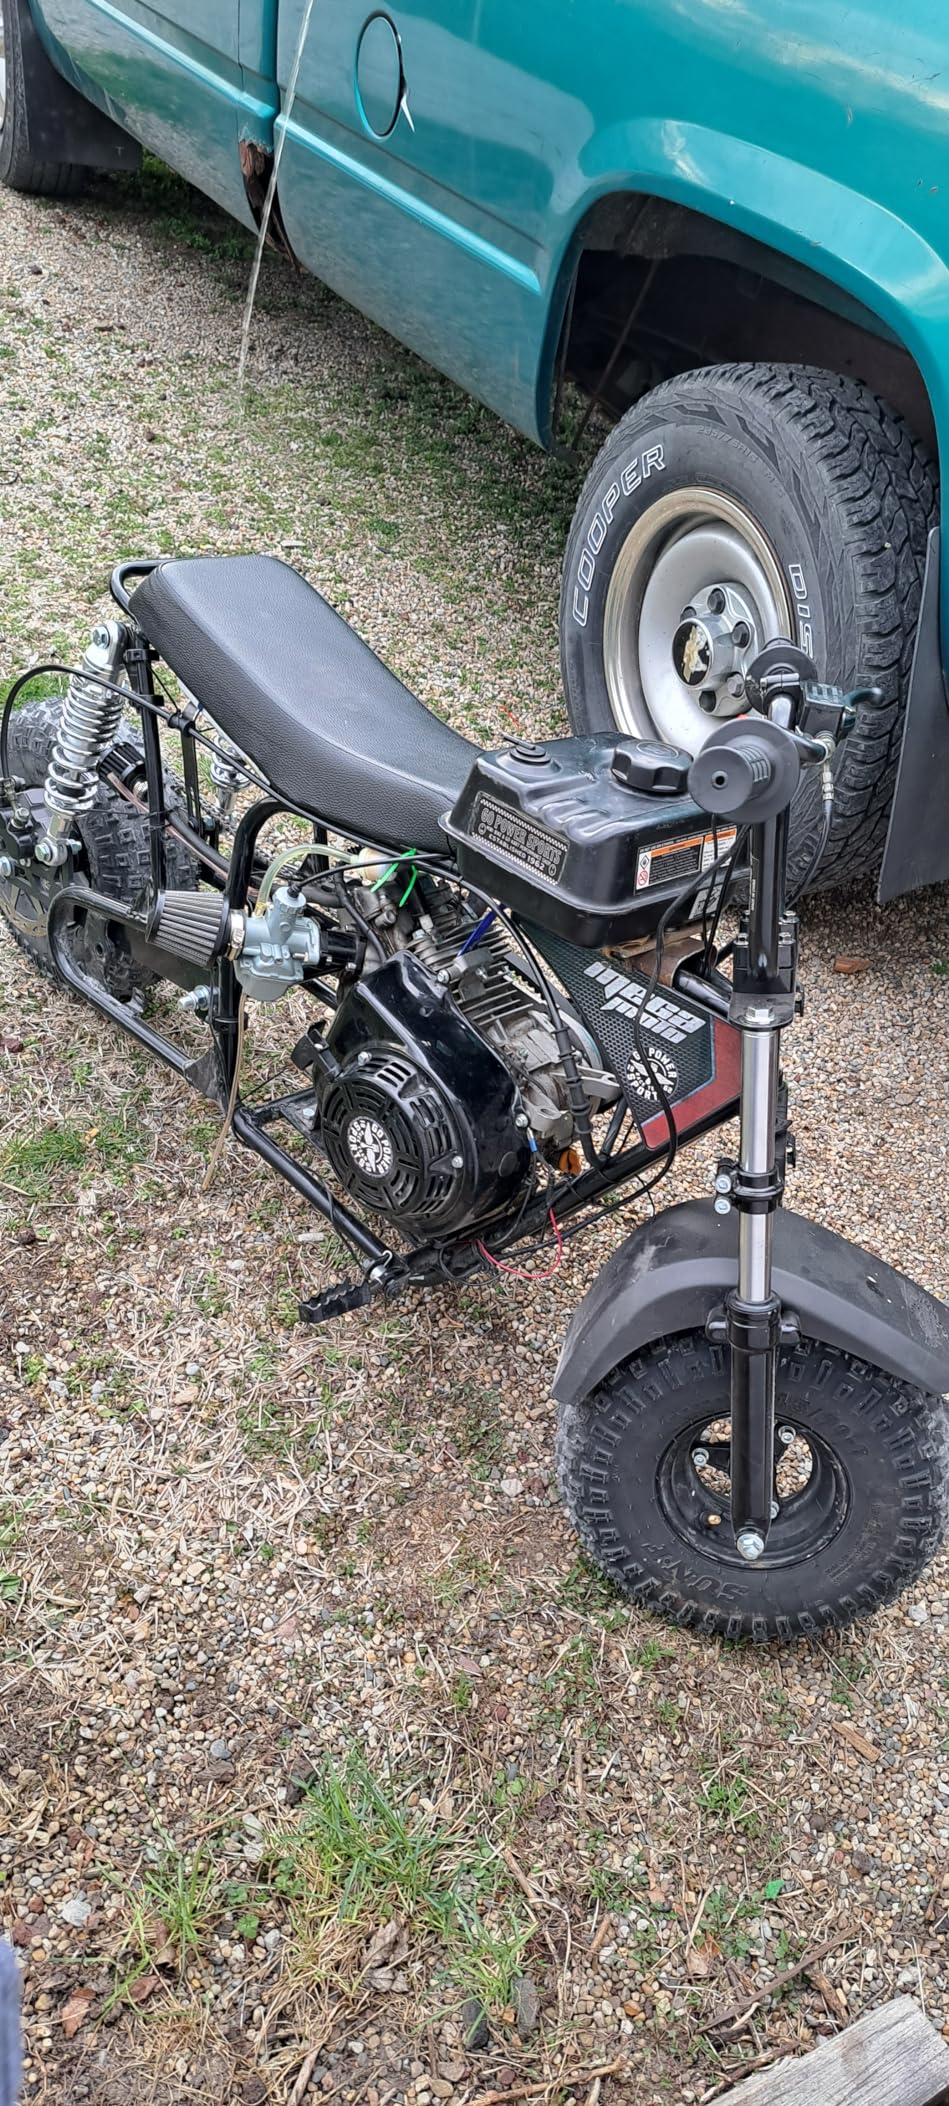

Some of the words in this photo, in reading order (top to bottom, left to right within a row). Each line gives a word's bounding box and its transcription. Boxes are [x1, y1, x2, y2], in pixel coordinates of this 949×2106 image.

[572, 444, 666, 627] COOPER
[481, 807, 495, 826] GO
[495, 815, 527, 845] POWER
[526, 833, 562, 865] SPORTS
[488, 834, 527, 859] ESTABLISHED
[527, 855, 546, 871] 1962
[648, 1047, 678, 1079] POWER
[626, 1073, 660, 1101] SPORT
[348, 1121, 366, 1168] SPORTS
[371, 1123, 384, 1138] GO
[377, 1140, 391, 1174] POWER
